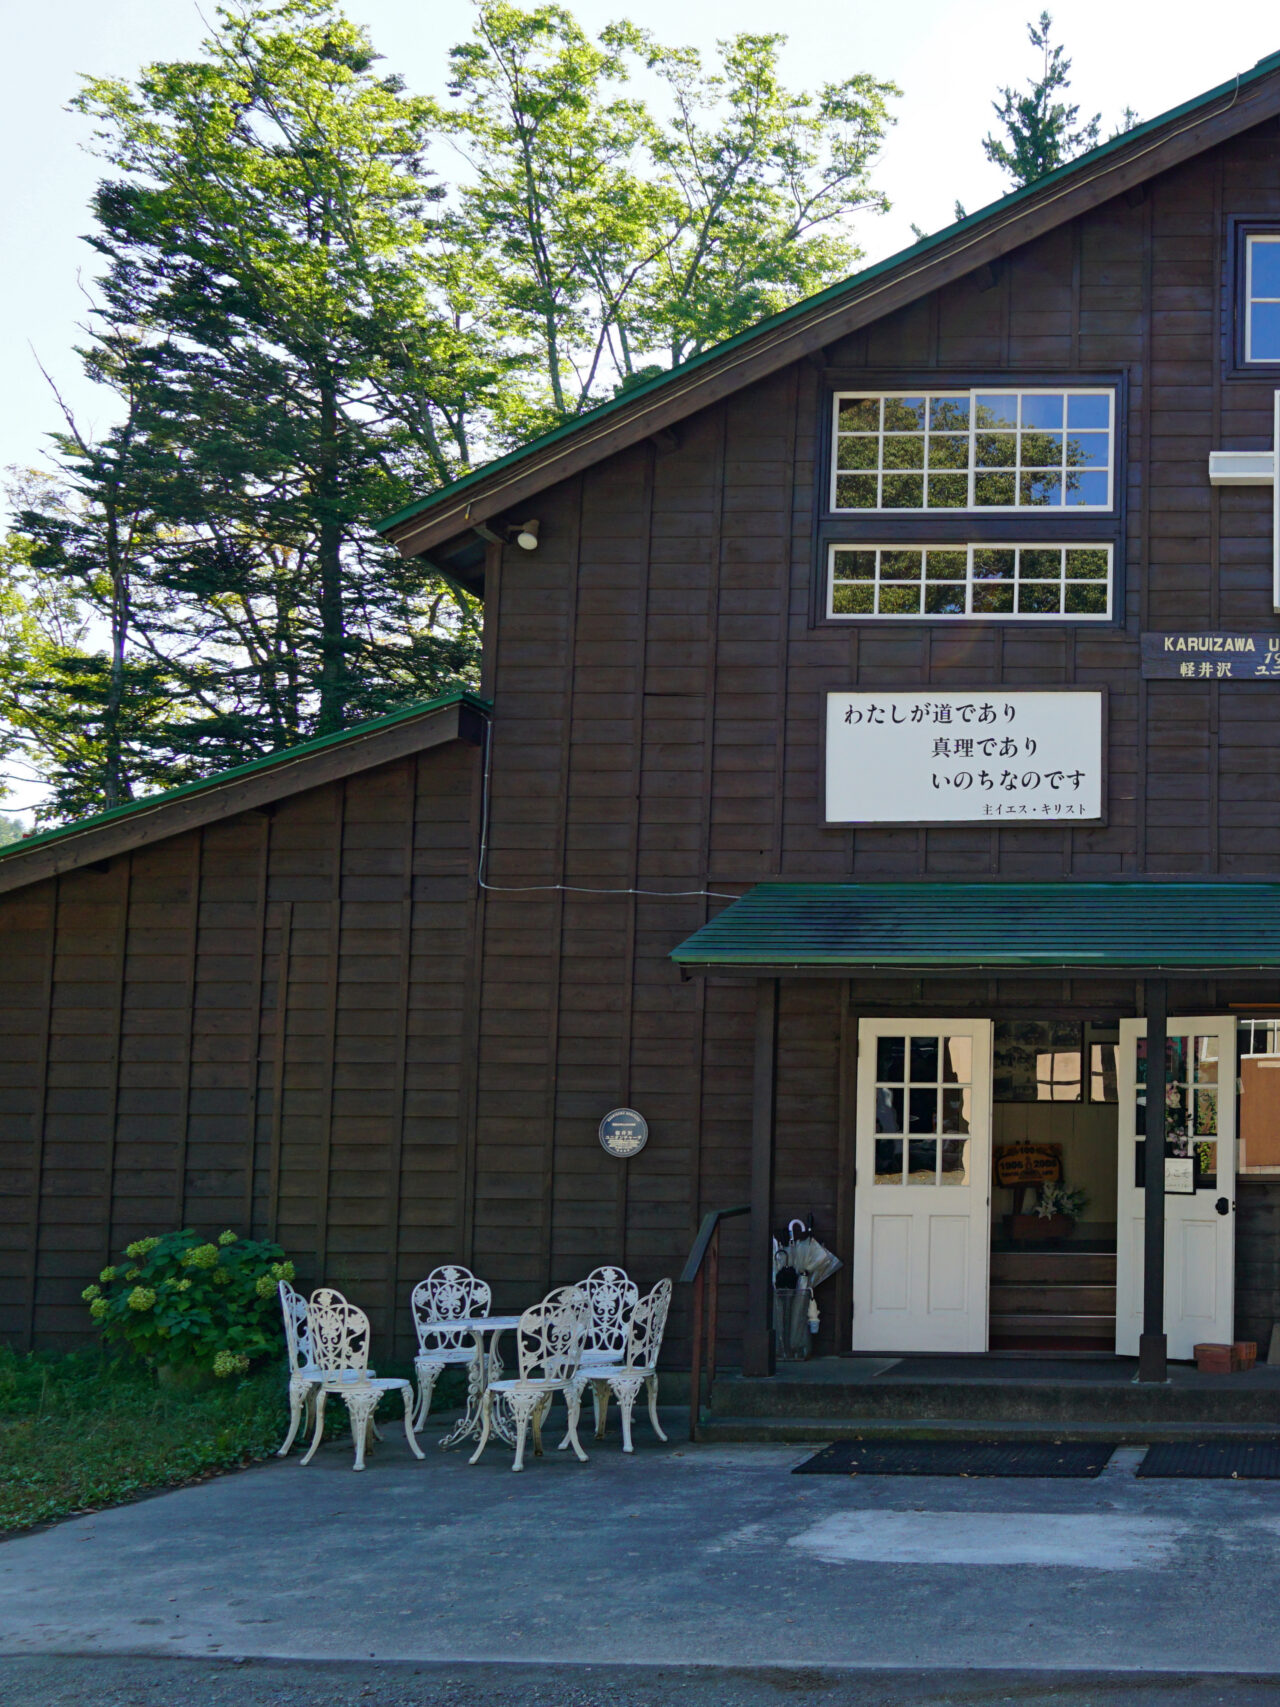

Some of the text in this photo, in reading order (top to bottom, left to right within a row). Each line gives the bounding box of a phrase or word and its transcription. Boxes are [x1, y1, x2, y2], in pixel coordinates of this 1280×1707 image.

[1164, 636, 1256, 652] KARUIZAWA
[1179, 661, 1233, 678] 軽井沢
[844, 702, 1016, 725] わたしが道であり
[931, 736, 1037, 759] 真理であり
[932, 769, 1086, 791] いのちなのです
[982, 803, 1087, 816] 主イエス・キリスト
